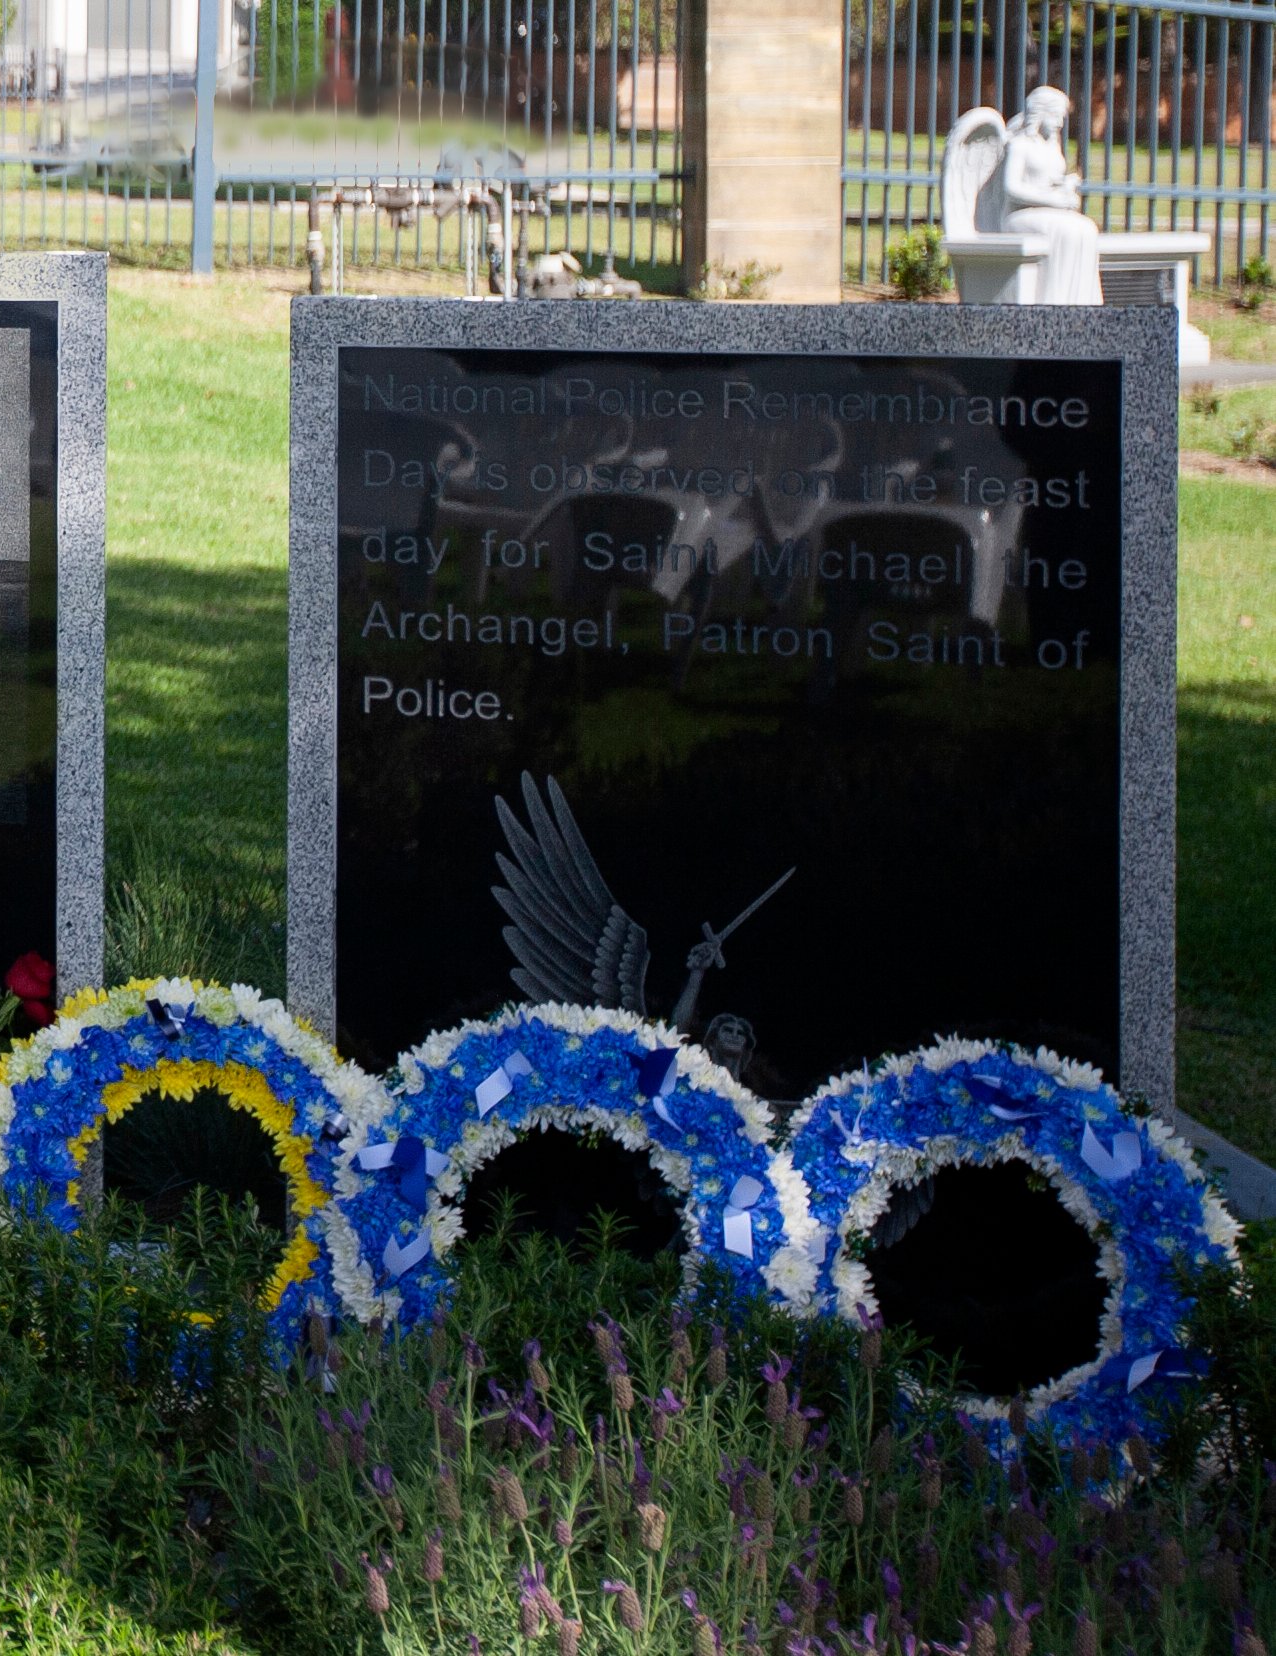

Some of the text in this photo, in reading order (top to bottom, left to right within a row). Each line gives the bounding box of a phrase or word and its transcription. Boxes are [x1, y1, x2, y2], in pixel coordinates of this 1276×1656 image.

[363, 374, 1090, 428] National Police Remembrance
[364, 450, 1091, 509] Day is observed on the feast
[362, 529, 1088, 590] day for Saint Michael the
[361, 601, 1090, 670] Archangel, Patron Saint of
[363, 675, 515, 722] Police.
